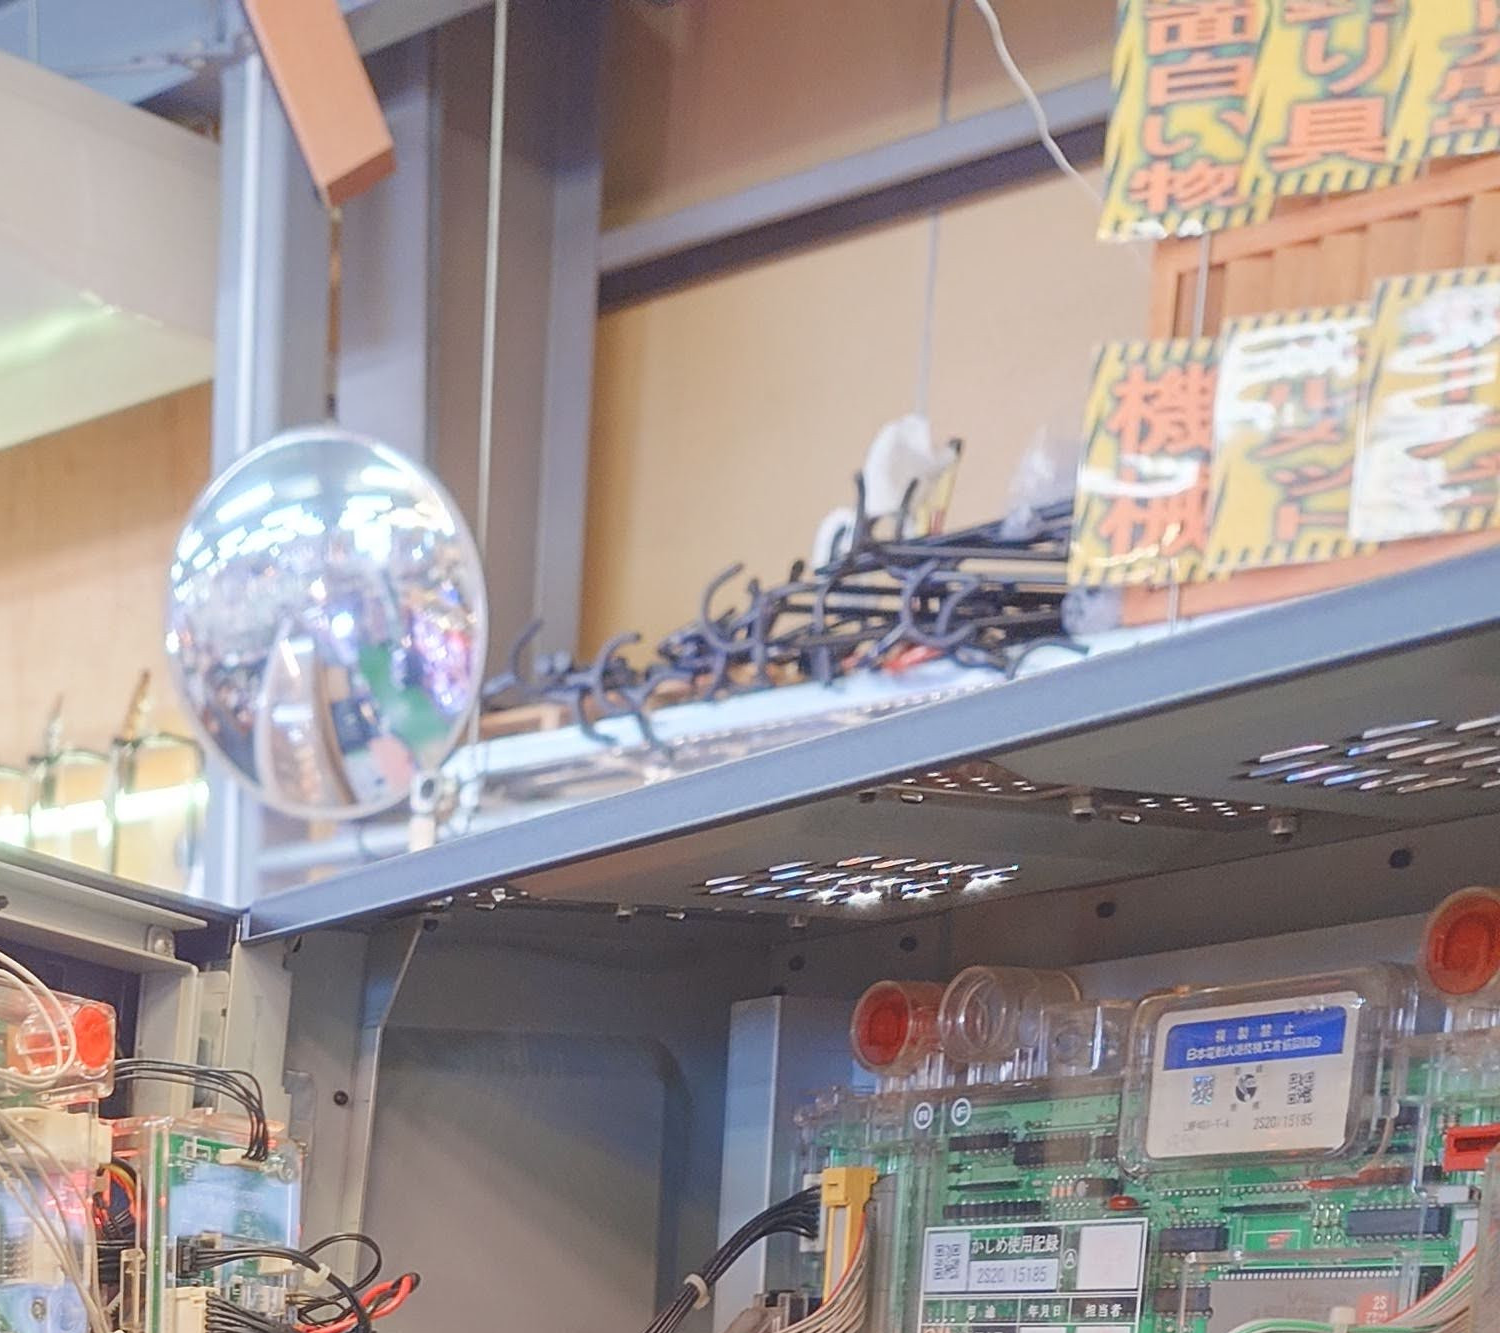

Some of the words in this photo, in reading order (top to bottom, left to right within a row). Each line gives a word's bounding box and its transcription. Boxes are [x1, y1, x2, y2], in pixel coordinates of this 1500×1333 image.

[1267, 0, 1388, 171] り具
[971, 1234, 1060, 1255] かしめ使用記録
[1028, 1304, 1063, 1318] 年月日
[1085, 1303, 1123, 1318] 担当者
